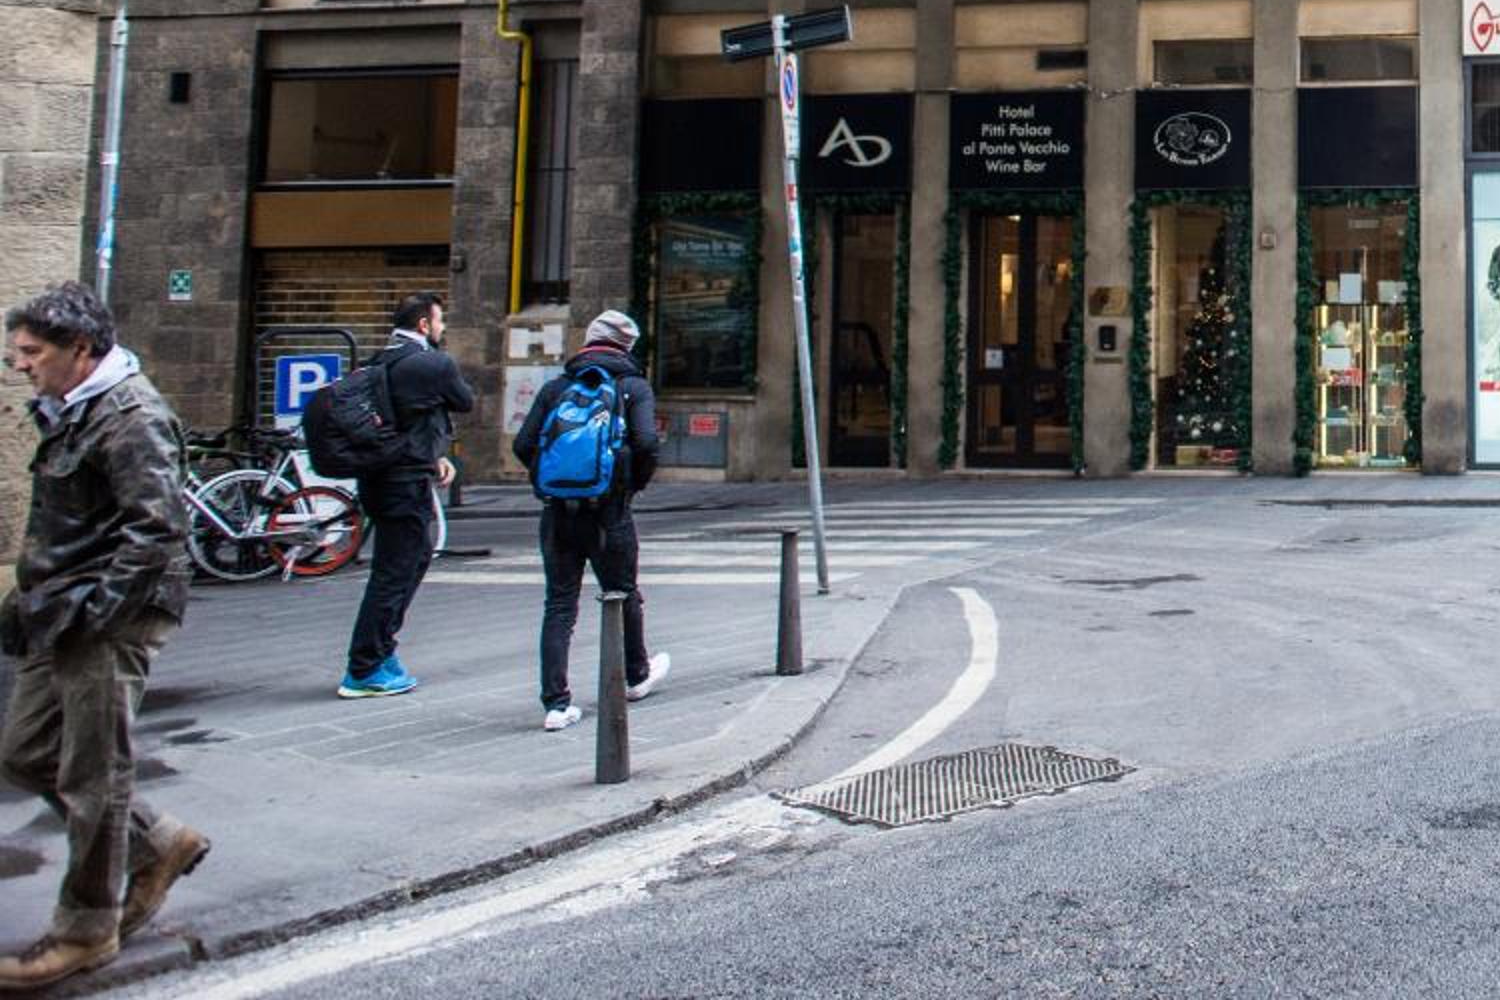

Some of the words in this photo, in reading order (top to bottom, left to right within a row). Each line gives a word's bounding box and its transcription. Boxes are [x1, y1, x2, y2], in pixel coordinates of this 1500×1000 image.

[999, 105, 1035, 119] Hotel
[981, 123, 1006, 137] Pitti
[1009, 123, 1052, 137] Palace
[963, 142, 975, 156] al
[979, 142, 1016, 156] Ponte
[1019, 141, 1071, 155] Vecchio
[986, 160, 1019, 174] Wine
[1023, 160, 1047, 173] Bar
[289, 362, 328, 409] P
